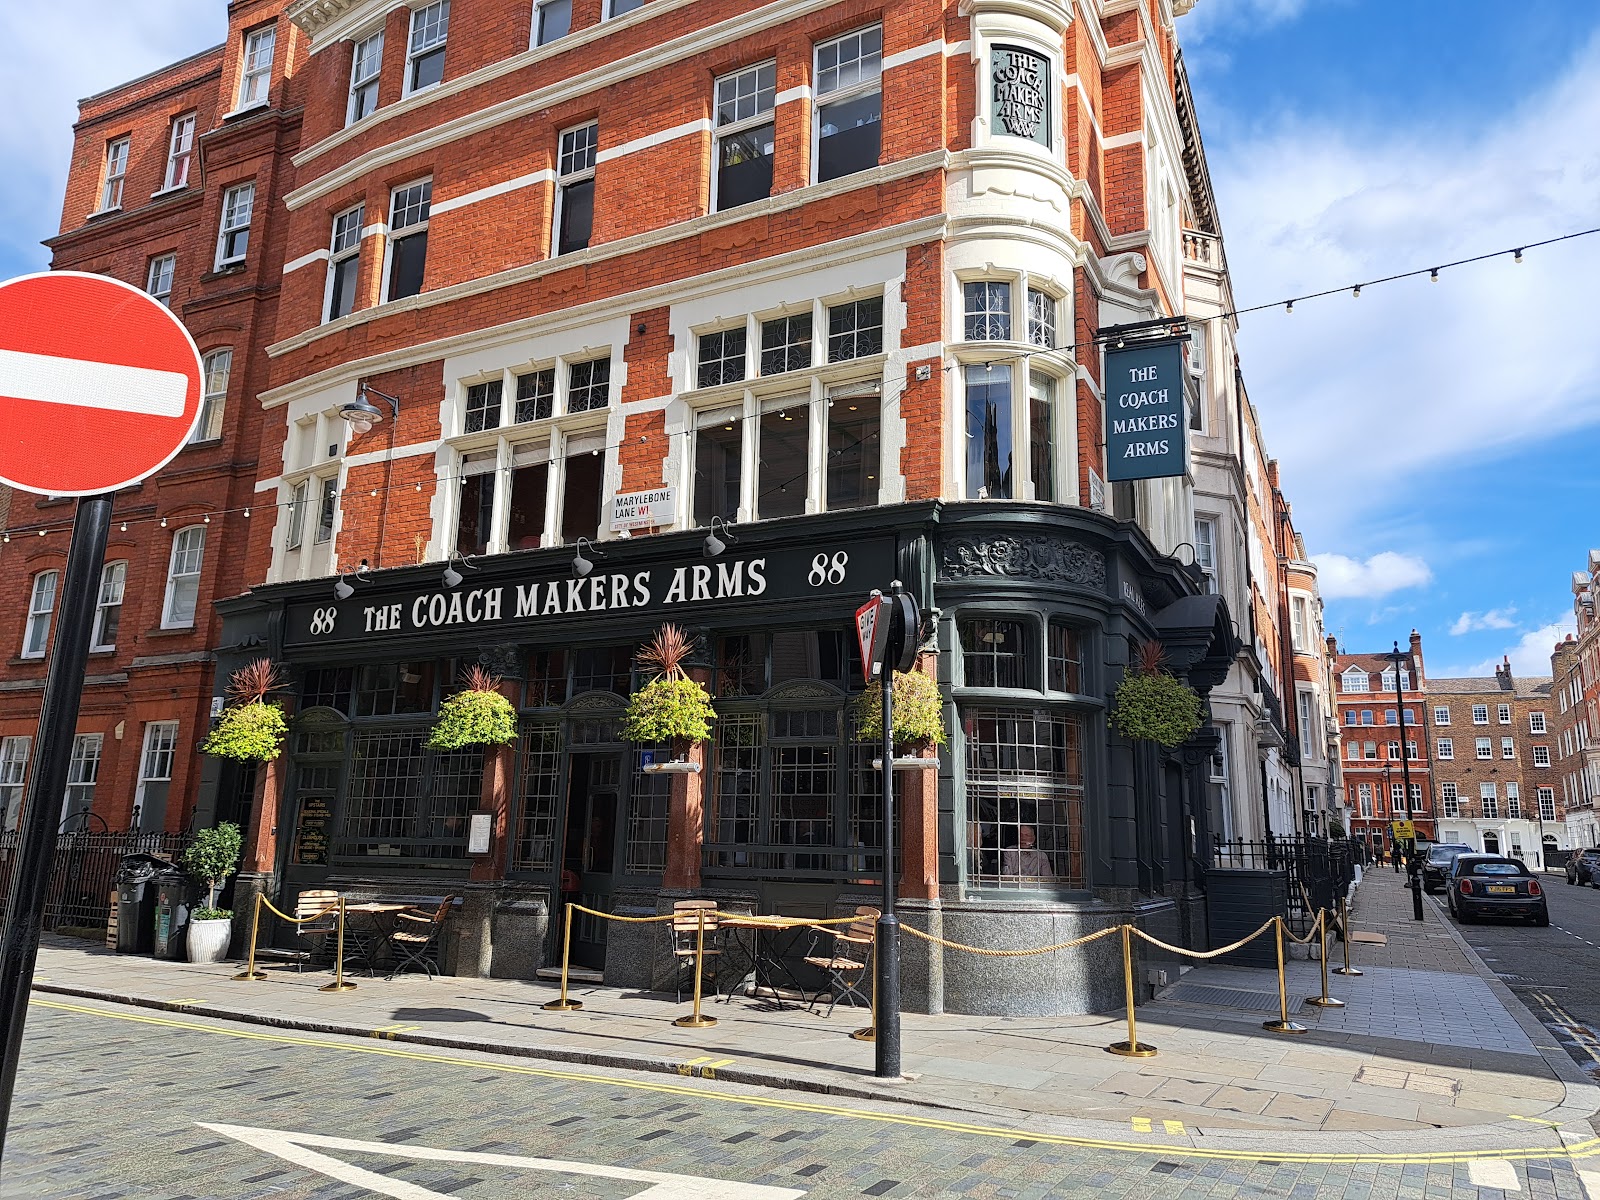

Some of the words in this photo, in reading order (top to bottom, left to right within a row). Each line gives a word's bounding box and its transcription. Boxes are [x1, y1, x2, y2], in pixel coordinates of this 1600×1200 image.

[1006, 53, 1038, 72] THE
[993, 65, 1043, 92] COACH
[994, 82, 1044, 111] MAKERS
[997, 101, 1042, 124] ARMS
[1129, 365, 1158, 383] THE
[1119, 388, 1170, 410] COACH
[1112, 413, 1178, 435] MAKERS
[1123, 440, 1169, 459] ARMS
[615, 490, 671, 507] MARYLEBONE
[615, 507, 635, 519] LANE
[309, 606, 337, 635] 88
[363, 603, 403, 632] THE
[412, 587, 504, 628] COACH
[513, 570, 651, 619] MAKERS
[662, 557, 767, 604] ARMS
[807, 550, 849, 587] 88
[860, 608, 874, 630] GIVE
